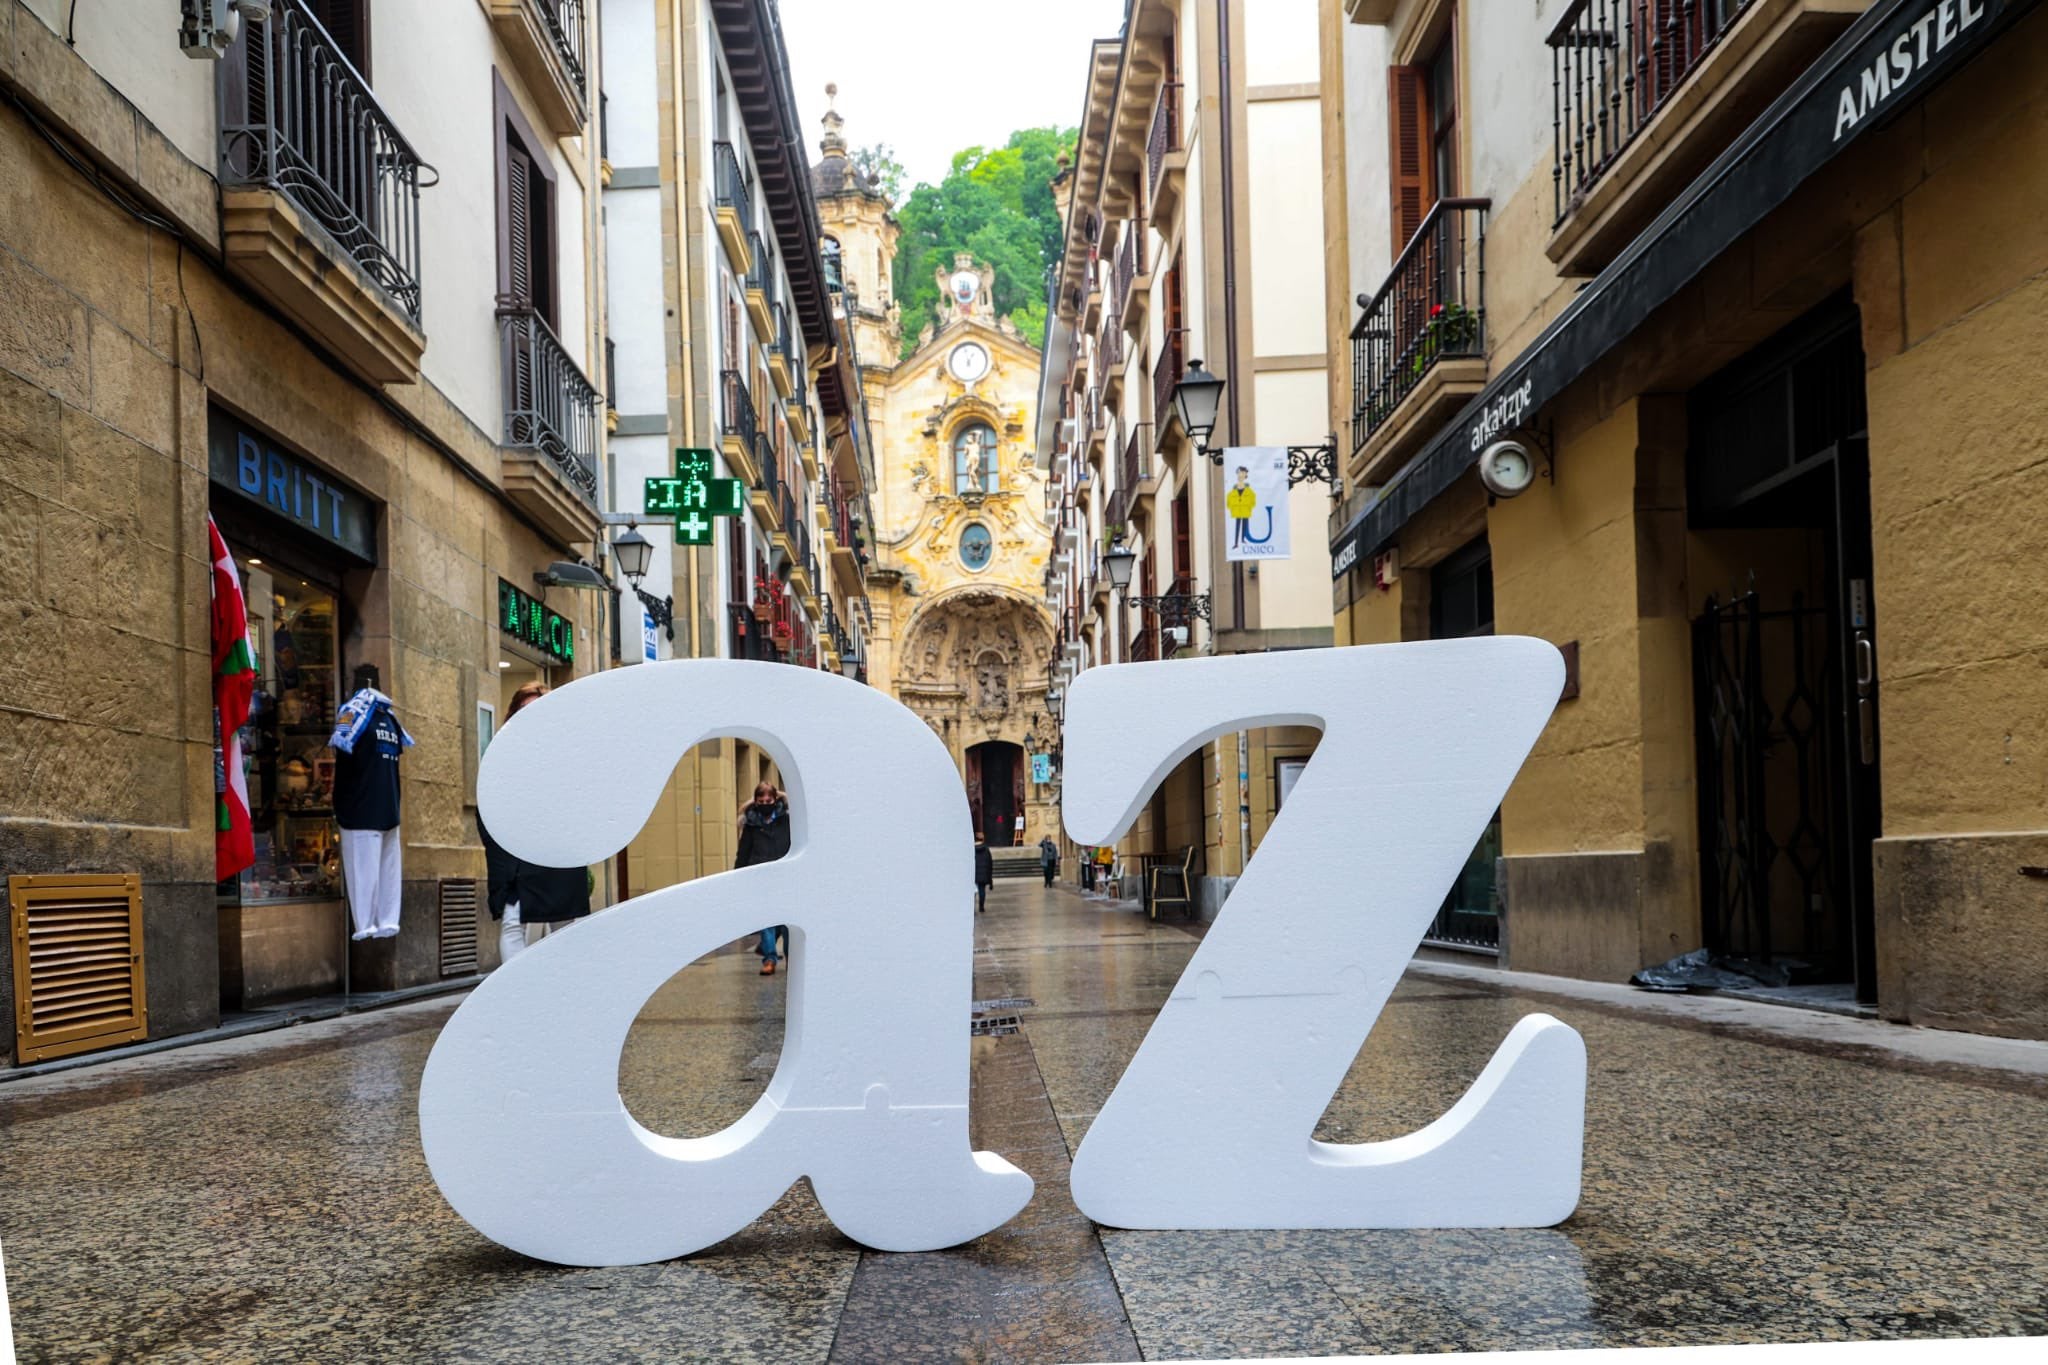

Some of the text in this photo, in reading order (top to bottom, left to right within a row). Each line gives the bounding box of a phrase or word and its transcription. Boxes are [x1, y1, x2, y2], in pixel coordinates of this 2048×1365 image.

[1832, 0, 1984, 142] AMSTEL
[1471, 379, 1531, 452] arkaitzpe
[238, 431, 344, 540] BRITT
[1333, 539, 1357, 576] AMSTEL
